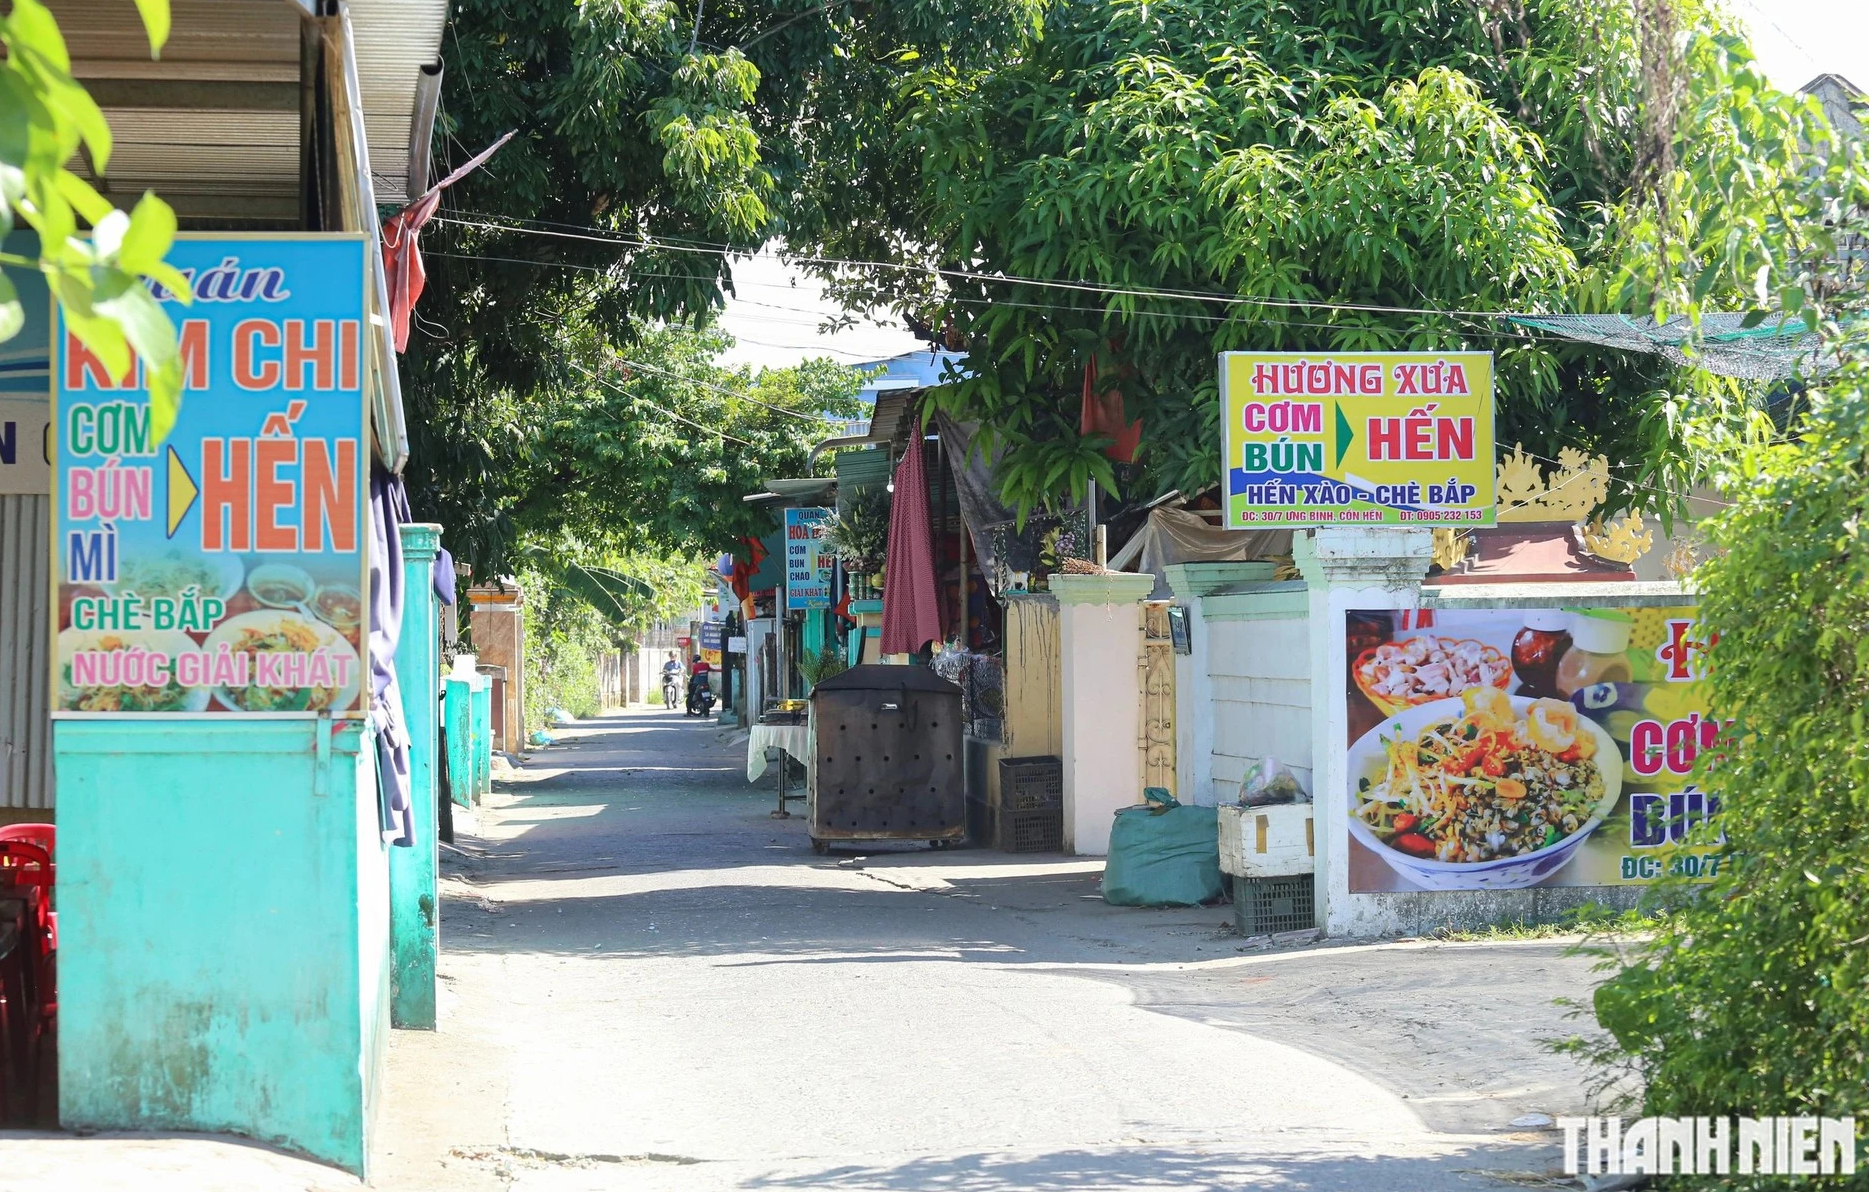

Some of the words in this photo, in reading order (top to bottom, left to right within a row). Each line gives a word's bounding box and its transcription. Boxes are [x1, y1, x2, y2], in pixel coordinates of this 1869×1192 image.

[233, 319, 358, 390] CHI
[1251, 361, 1382, 394] HƯƠNG
[1394, 360, 1468, 394] XƯA
[71, 403, 155, 453] CƠM
[1244, 401, 1321, 432] CƠM
[1368, 403, 1473, 460] HẾN
[203, 402, 356, 550] HẾN
[1245, 437, 1323, 472] BÚN
[71, 459, 150, 518] BÚN
[1247, 479, 1296, 504] HẾN
[1303, 481, 1350, 504] XÀO
[1376, 481, 1421, 504] CHÈ
[1428, 478, 1475, 504] BẮP
[1242, 511, 1259, 521] ĐC:
[1261, 511, 1283, 521] 30/7
[1400, 511, 1414, 521] ĐT:
[1443, 510, 1462, 520] 232
[1465, 510, 1482, 520] 153
[71, 523, 116, 581] MÌ
[817, 551, 833, 569] HẾ
[74, 592, 142, 630] CHÈ
[154, 587, 223, 631] BẮP
[75, 646, 168, 685] NƯỚC
[178, 643, 249, 686] GIẢI
[258, 647, 353, 686] KHÁT
[1632, 785, 1728, 846] BÚ
